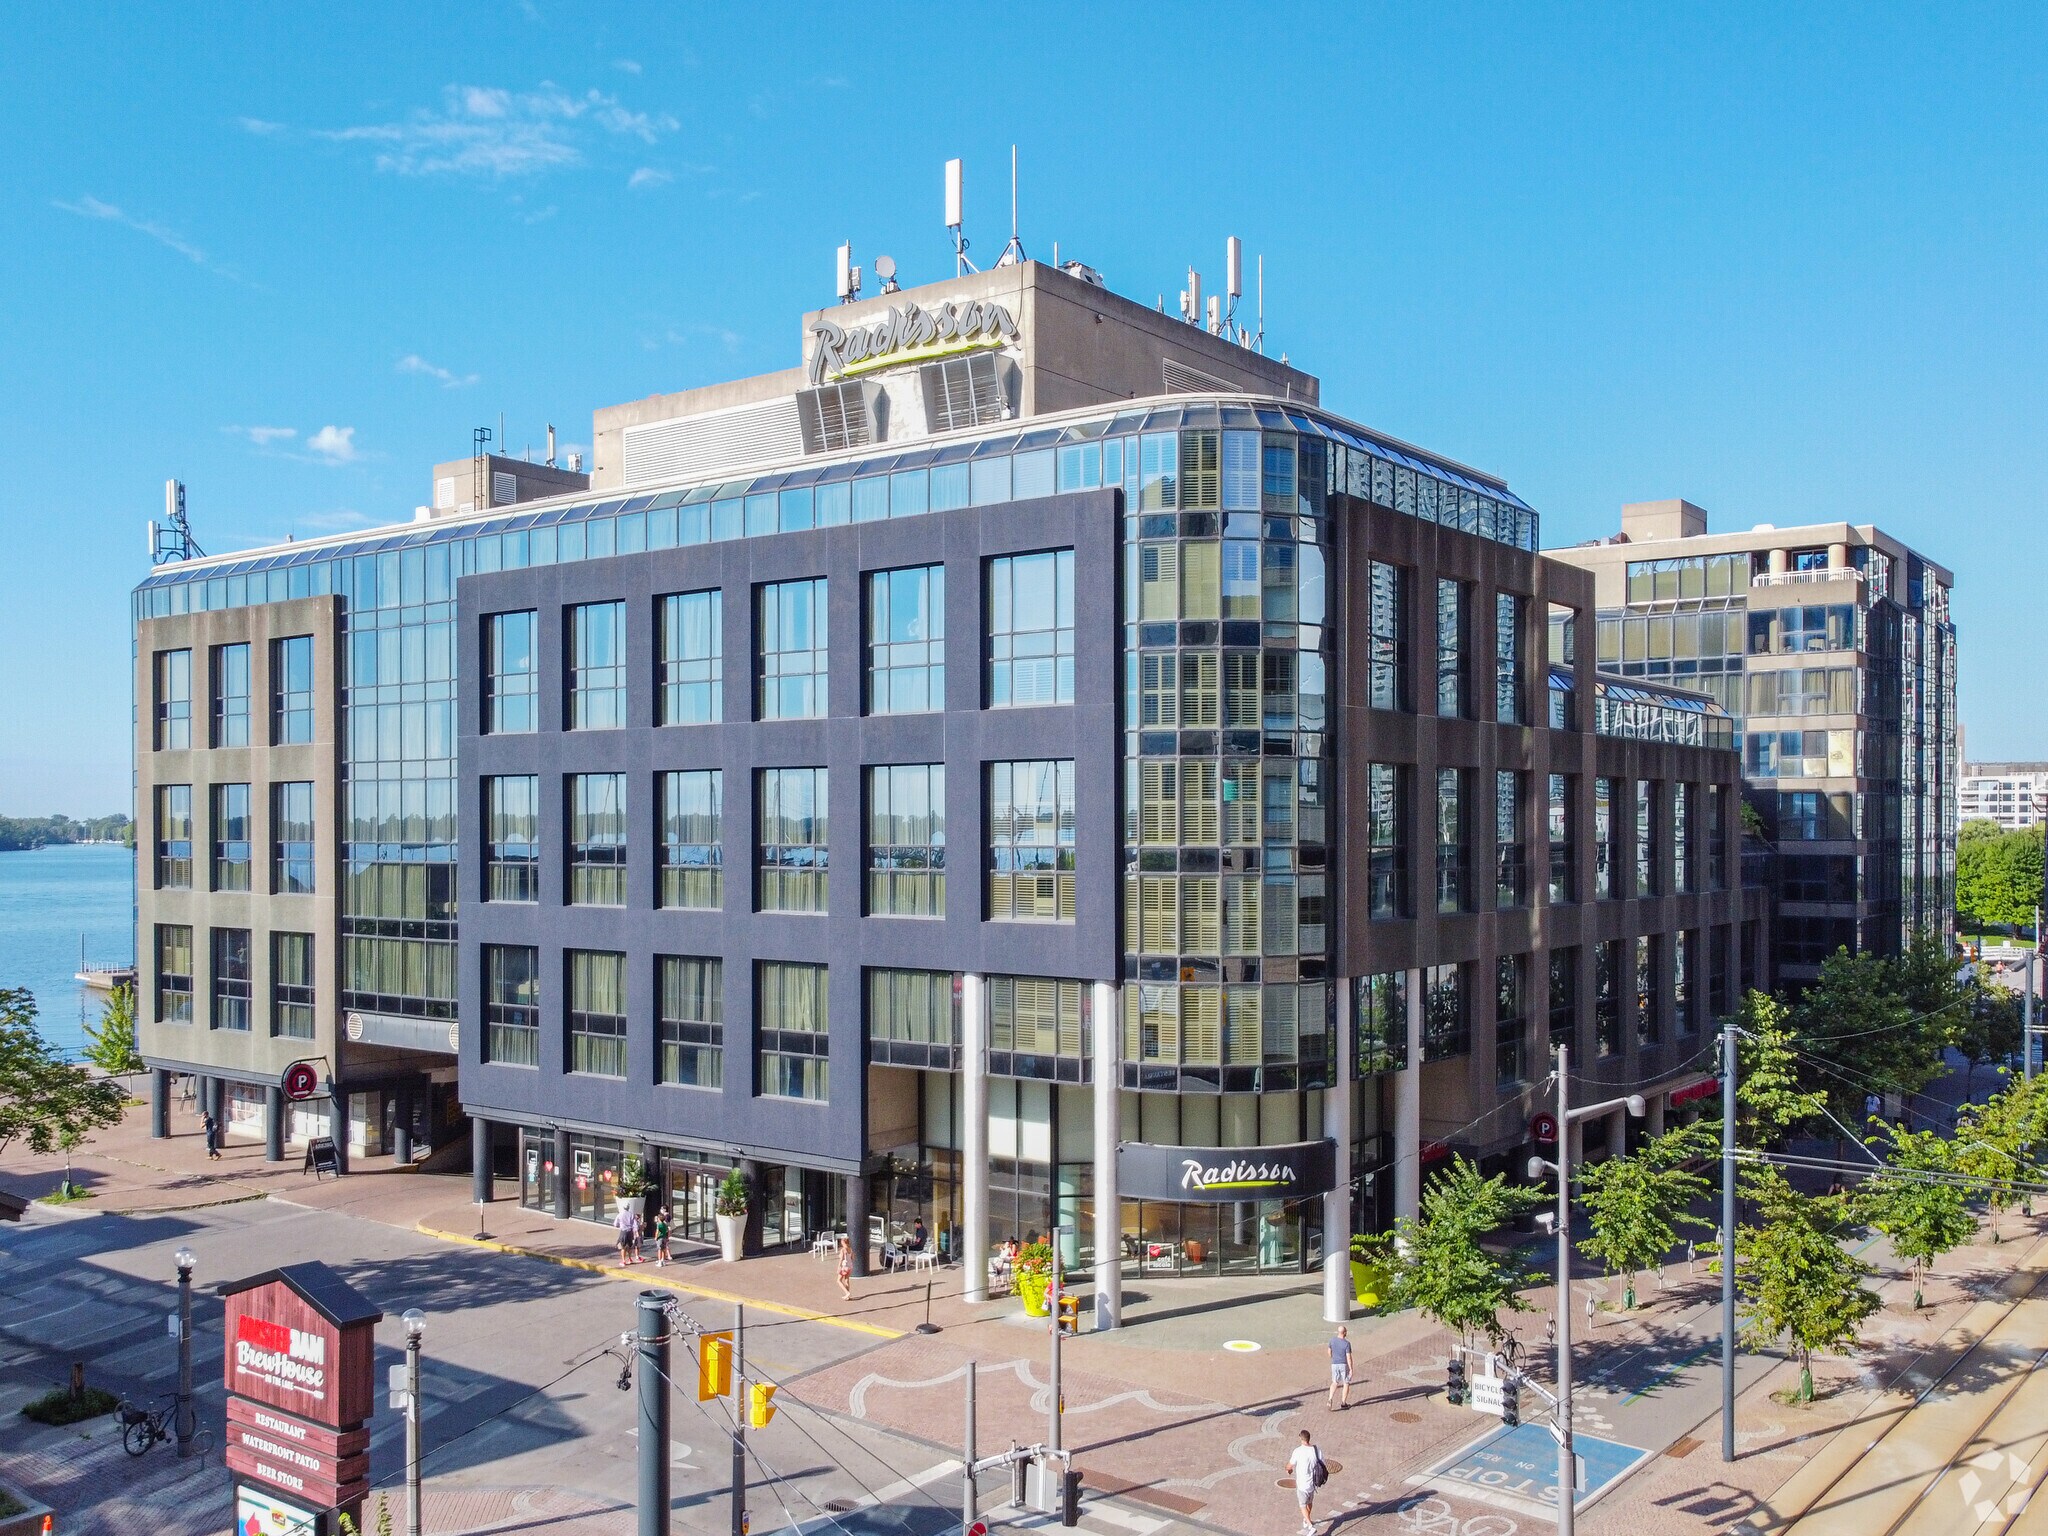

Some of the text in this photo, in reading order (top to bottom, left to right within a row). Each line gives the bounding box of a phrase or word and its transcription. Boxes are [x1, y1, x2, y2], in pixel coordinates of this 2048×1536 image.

[809, 300, 1017, 385] Radisson
[298, 1075, 307, 1088] P
[1541, 1122, 1550, 1134] P
[1181, 1159, 1297, 1190] Radisson
[236, 1341, 324, 1387] BrewHouse
[1474, 1382, 1503, 1394] BICYCLE
[1476, 1396, 1501, 1407] SIGNAL
[255, 1412, 306, 1440] RESTAURANT
[242, 1432, 320, 1471] WATERFRONT PATIO
[257, 1462, 304, 1491] BEER STORE
[1448, 1466, 1559, 1500] STOP
